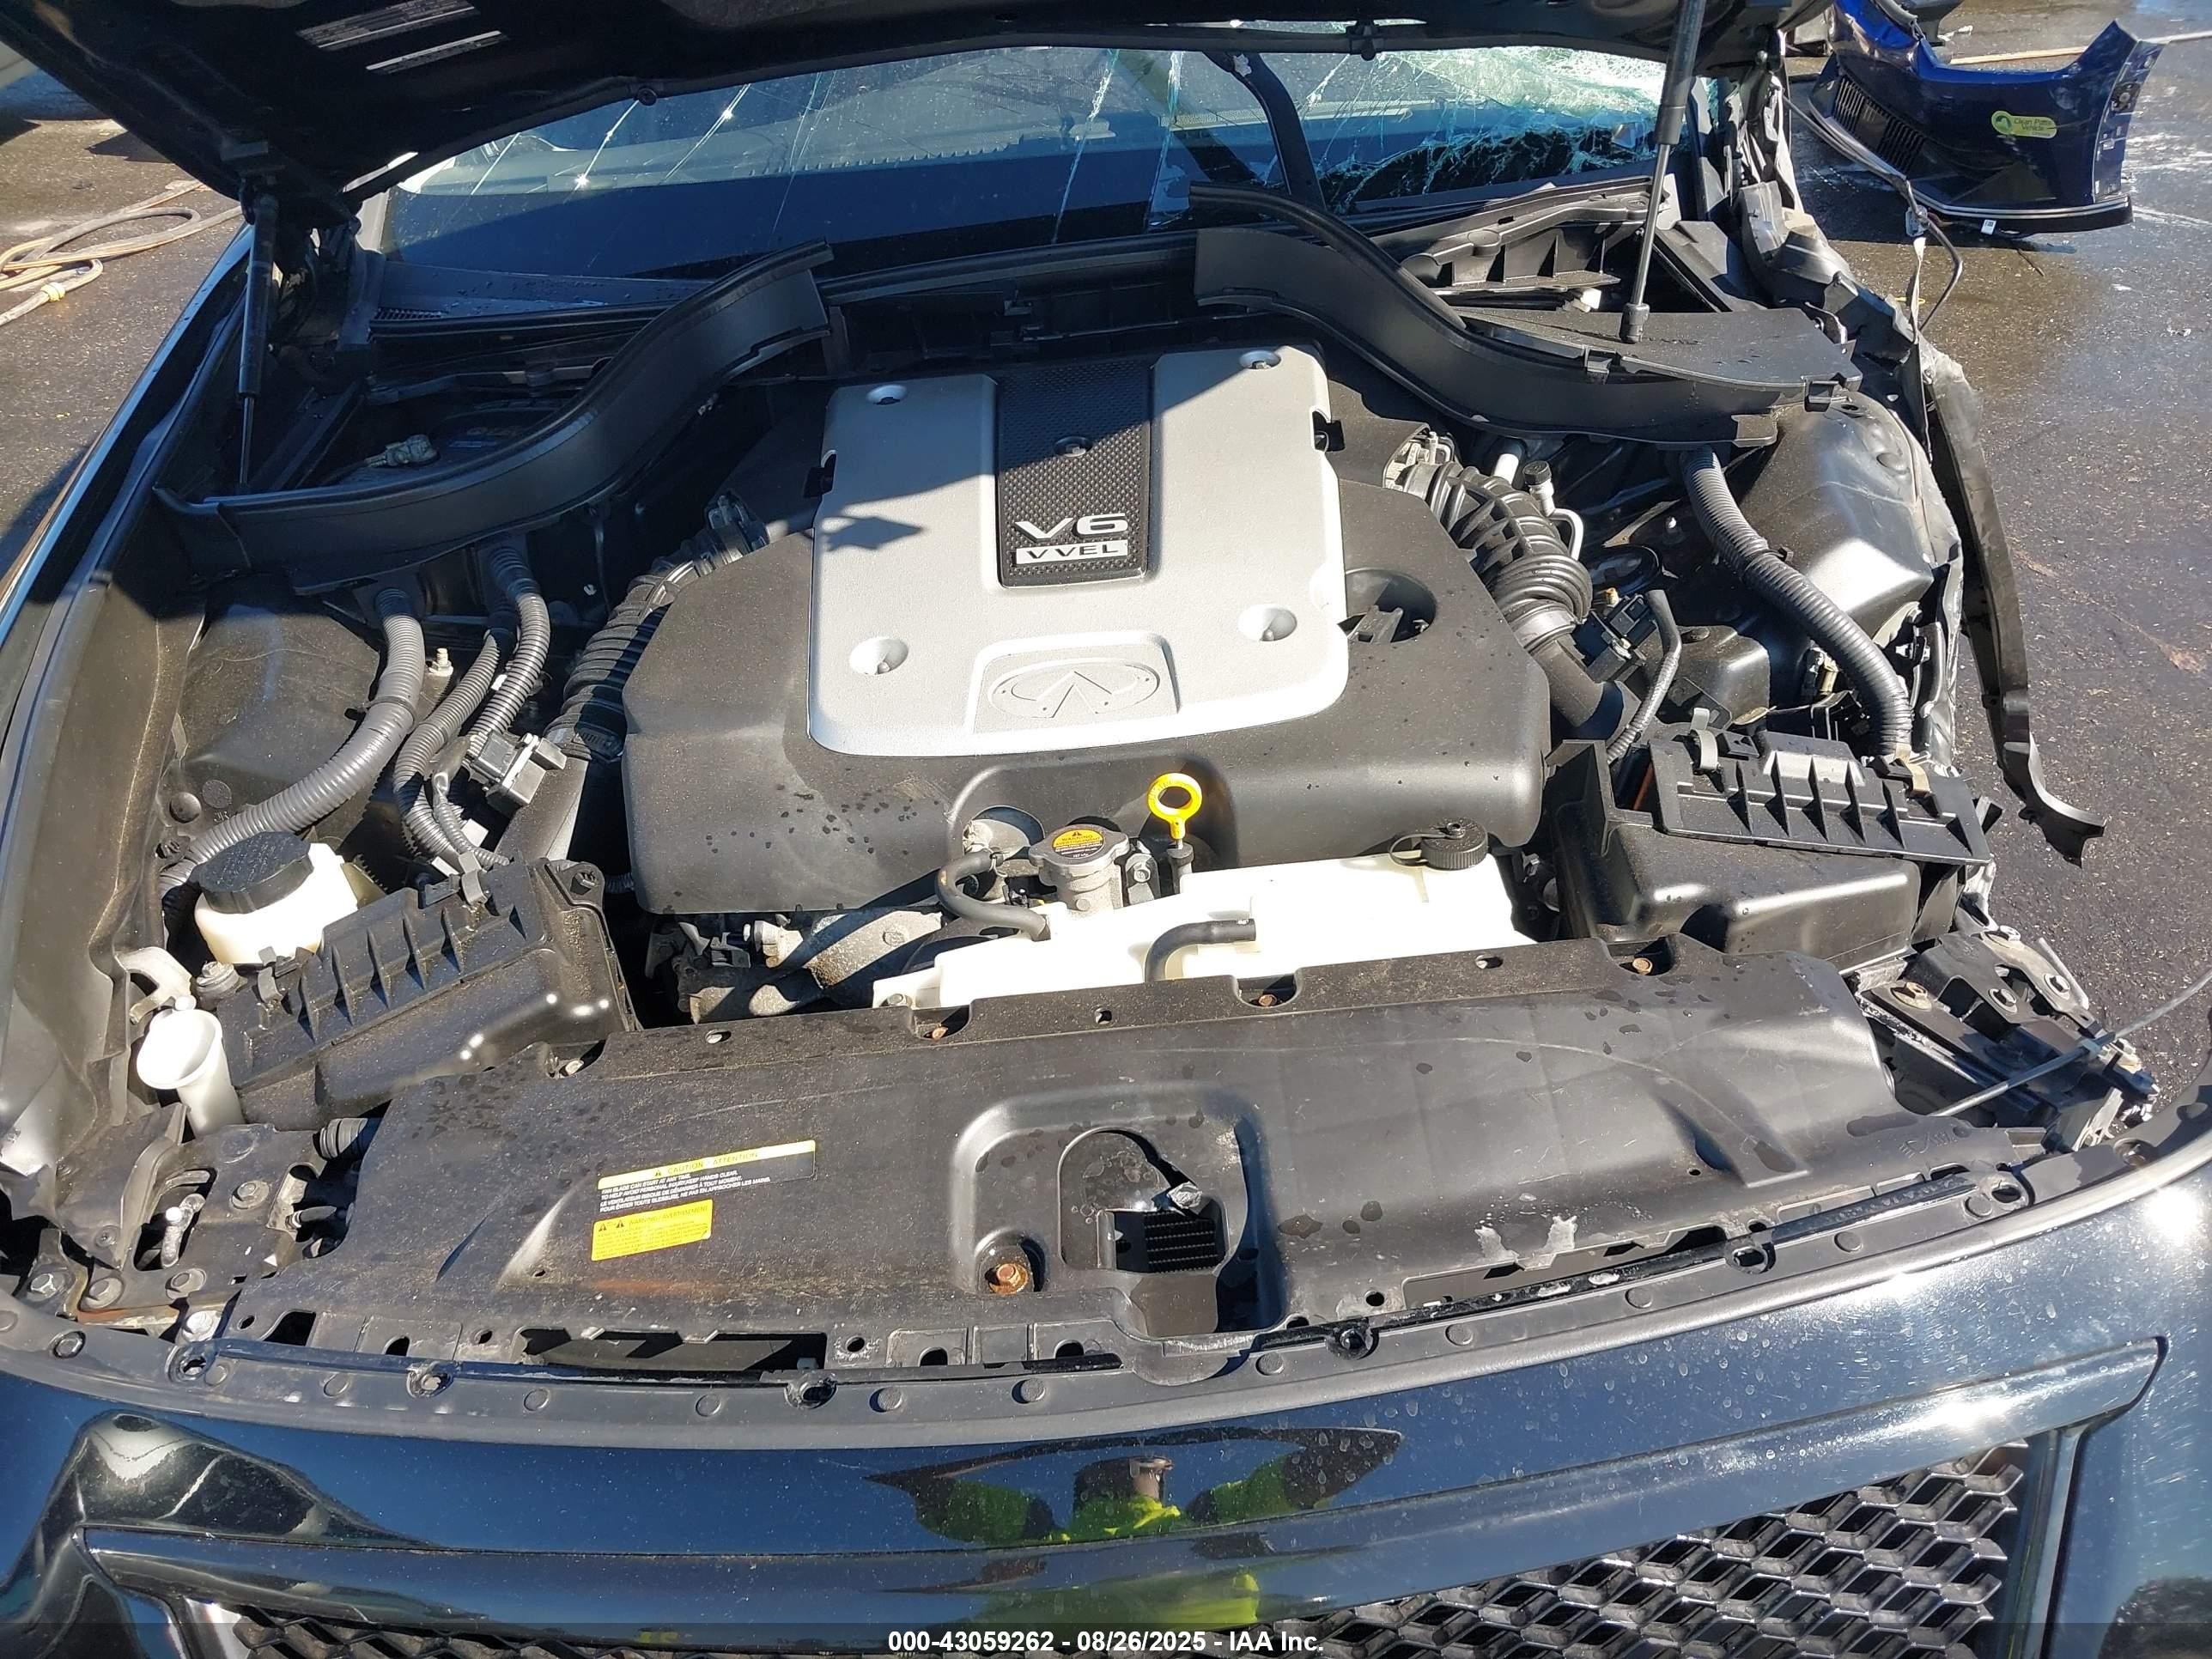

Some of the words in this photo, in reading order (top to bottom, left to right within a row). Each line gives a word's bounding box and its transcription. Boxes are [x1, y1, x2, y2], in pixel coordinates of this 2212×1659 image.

[1014, 513, 1128, 544] V6
[1027, 544, 1118, 558] VVEL
[667, 1160, 703, 1176] CAUTION
[713, 1153, 758, 1165] ATTENTION
